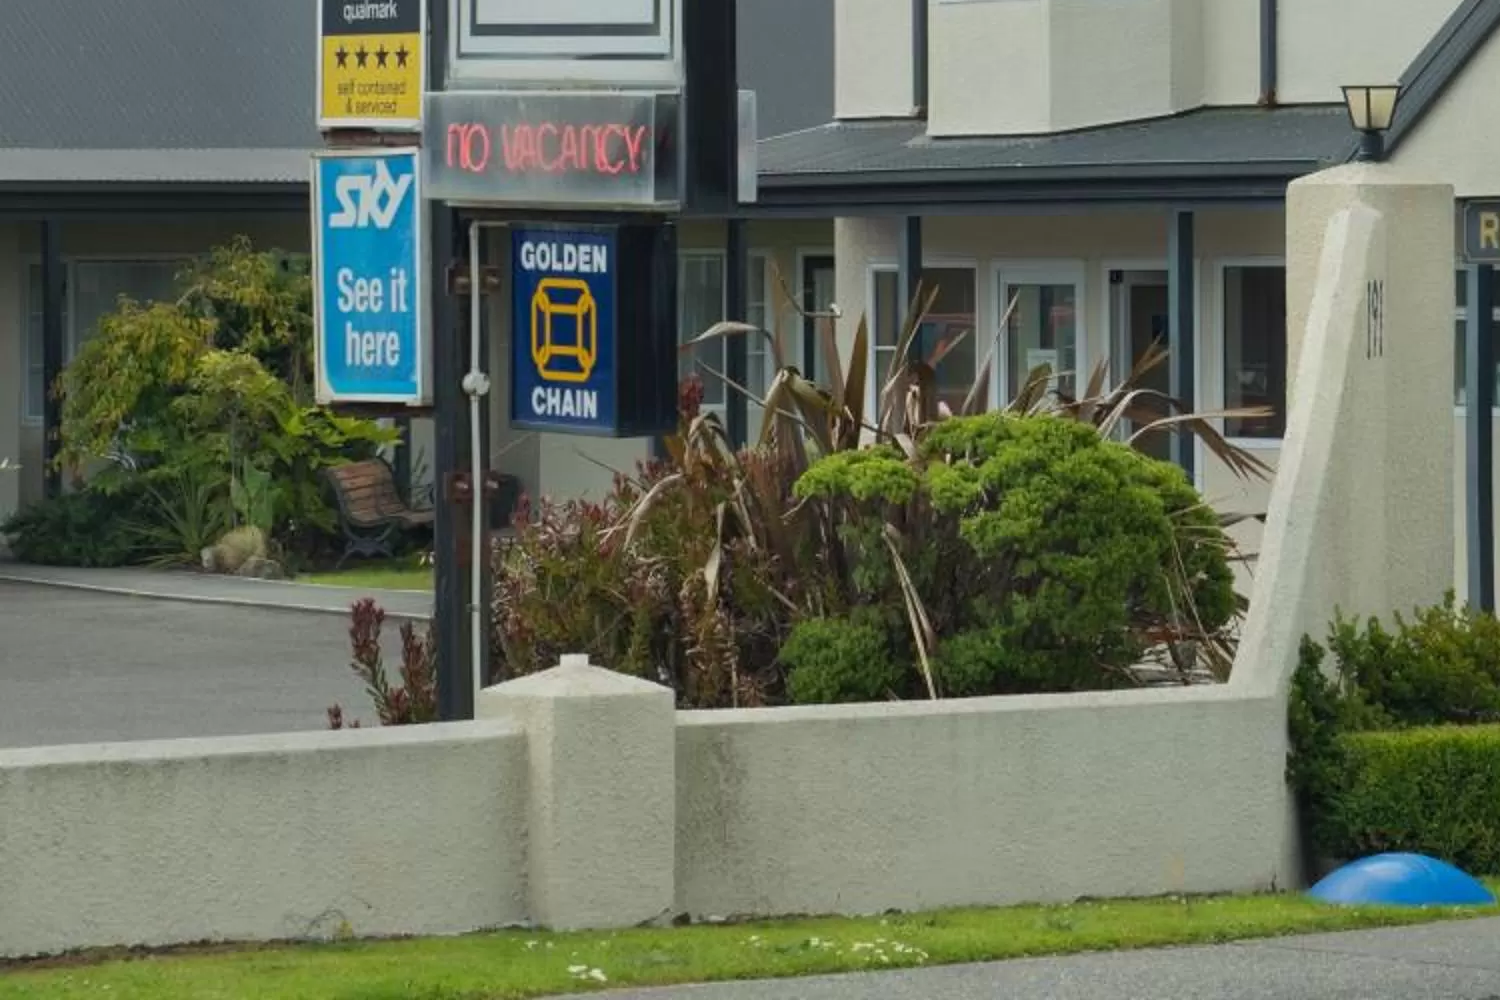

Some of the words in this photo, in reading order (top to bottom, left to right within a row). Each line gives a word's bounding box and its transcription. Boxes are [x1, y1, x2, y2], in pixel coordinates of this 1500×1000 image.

[329, 159, 414, 228] SKY
[520, 240, 608, 273] GOLDEN
[337, 267, 384, 313] See
[390, 267, 408, 313] it
[345, 321, 401, 367] here
[531, 385, 598, 420] CHAIN
